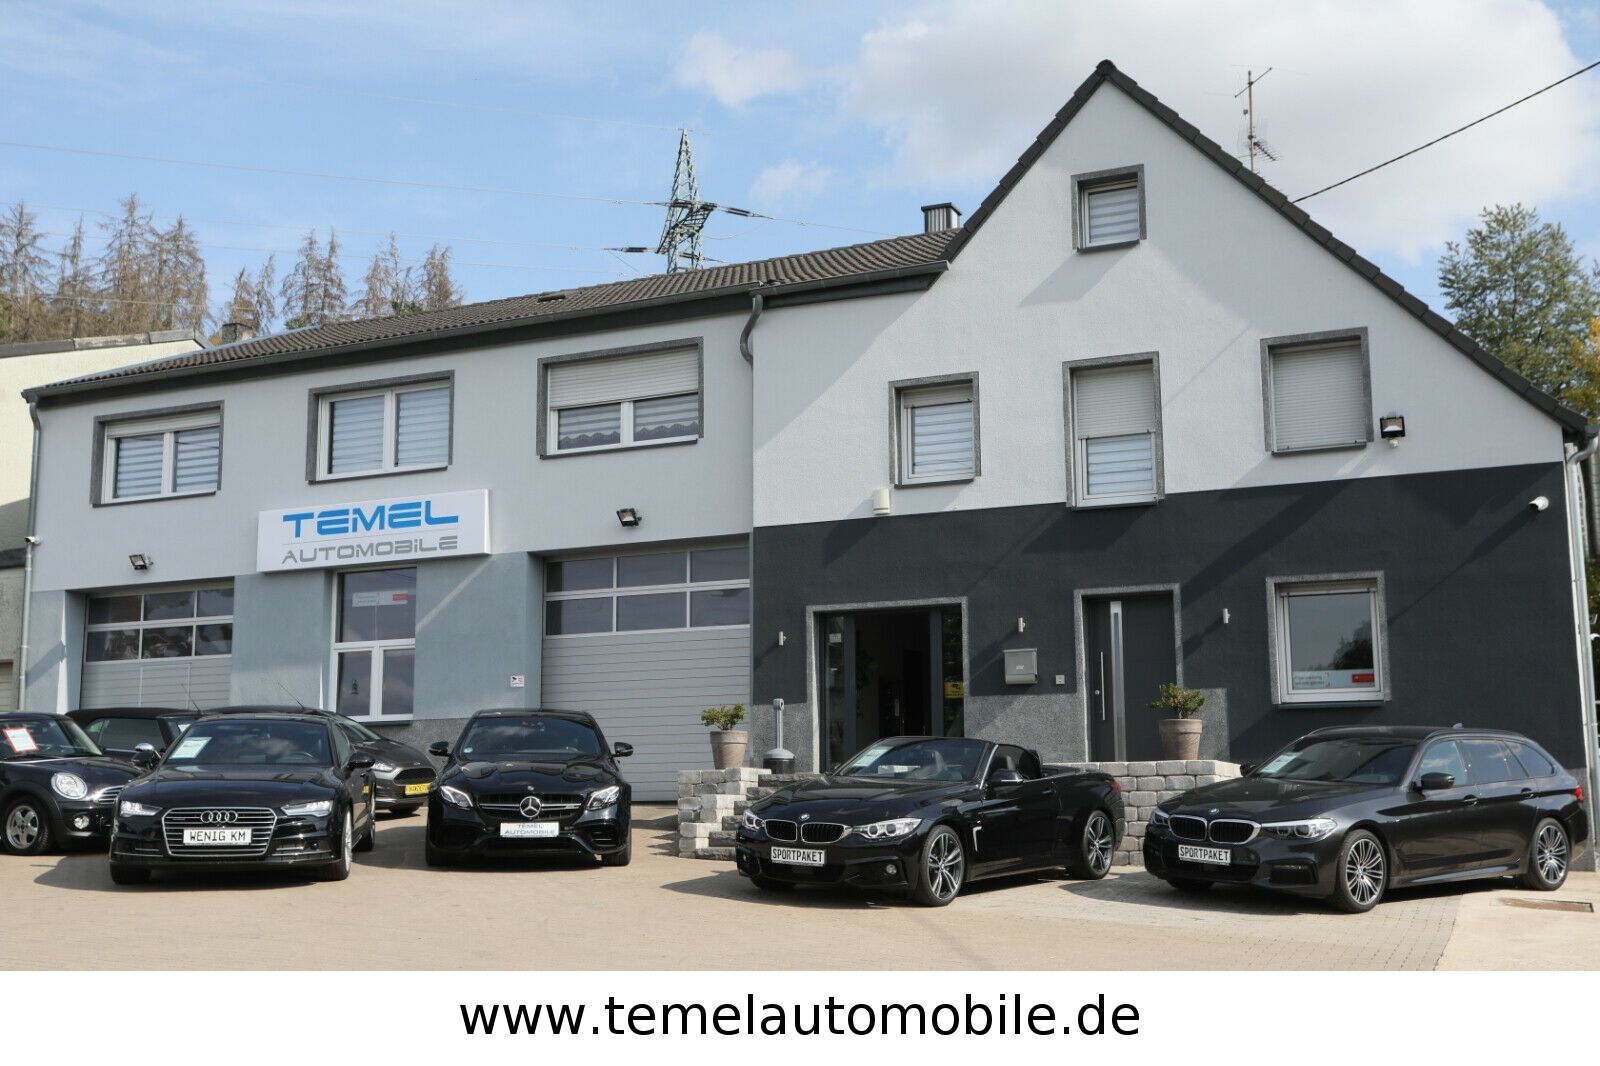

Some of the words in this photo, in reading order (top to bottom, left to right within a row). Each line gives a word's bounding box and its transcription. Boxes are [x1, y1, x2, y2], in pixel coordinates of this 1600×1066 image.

[282, 500, 459, 538] TEMEL
[189, 830, 226, 842] WENIG
[230, 830, 246, 842] KM
[772, 848, 823, 862] SPORTPAKET
[1180, 846, 1229, 861] SPORTPAKET
